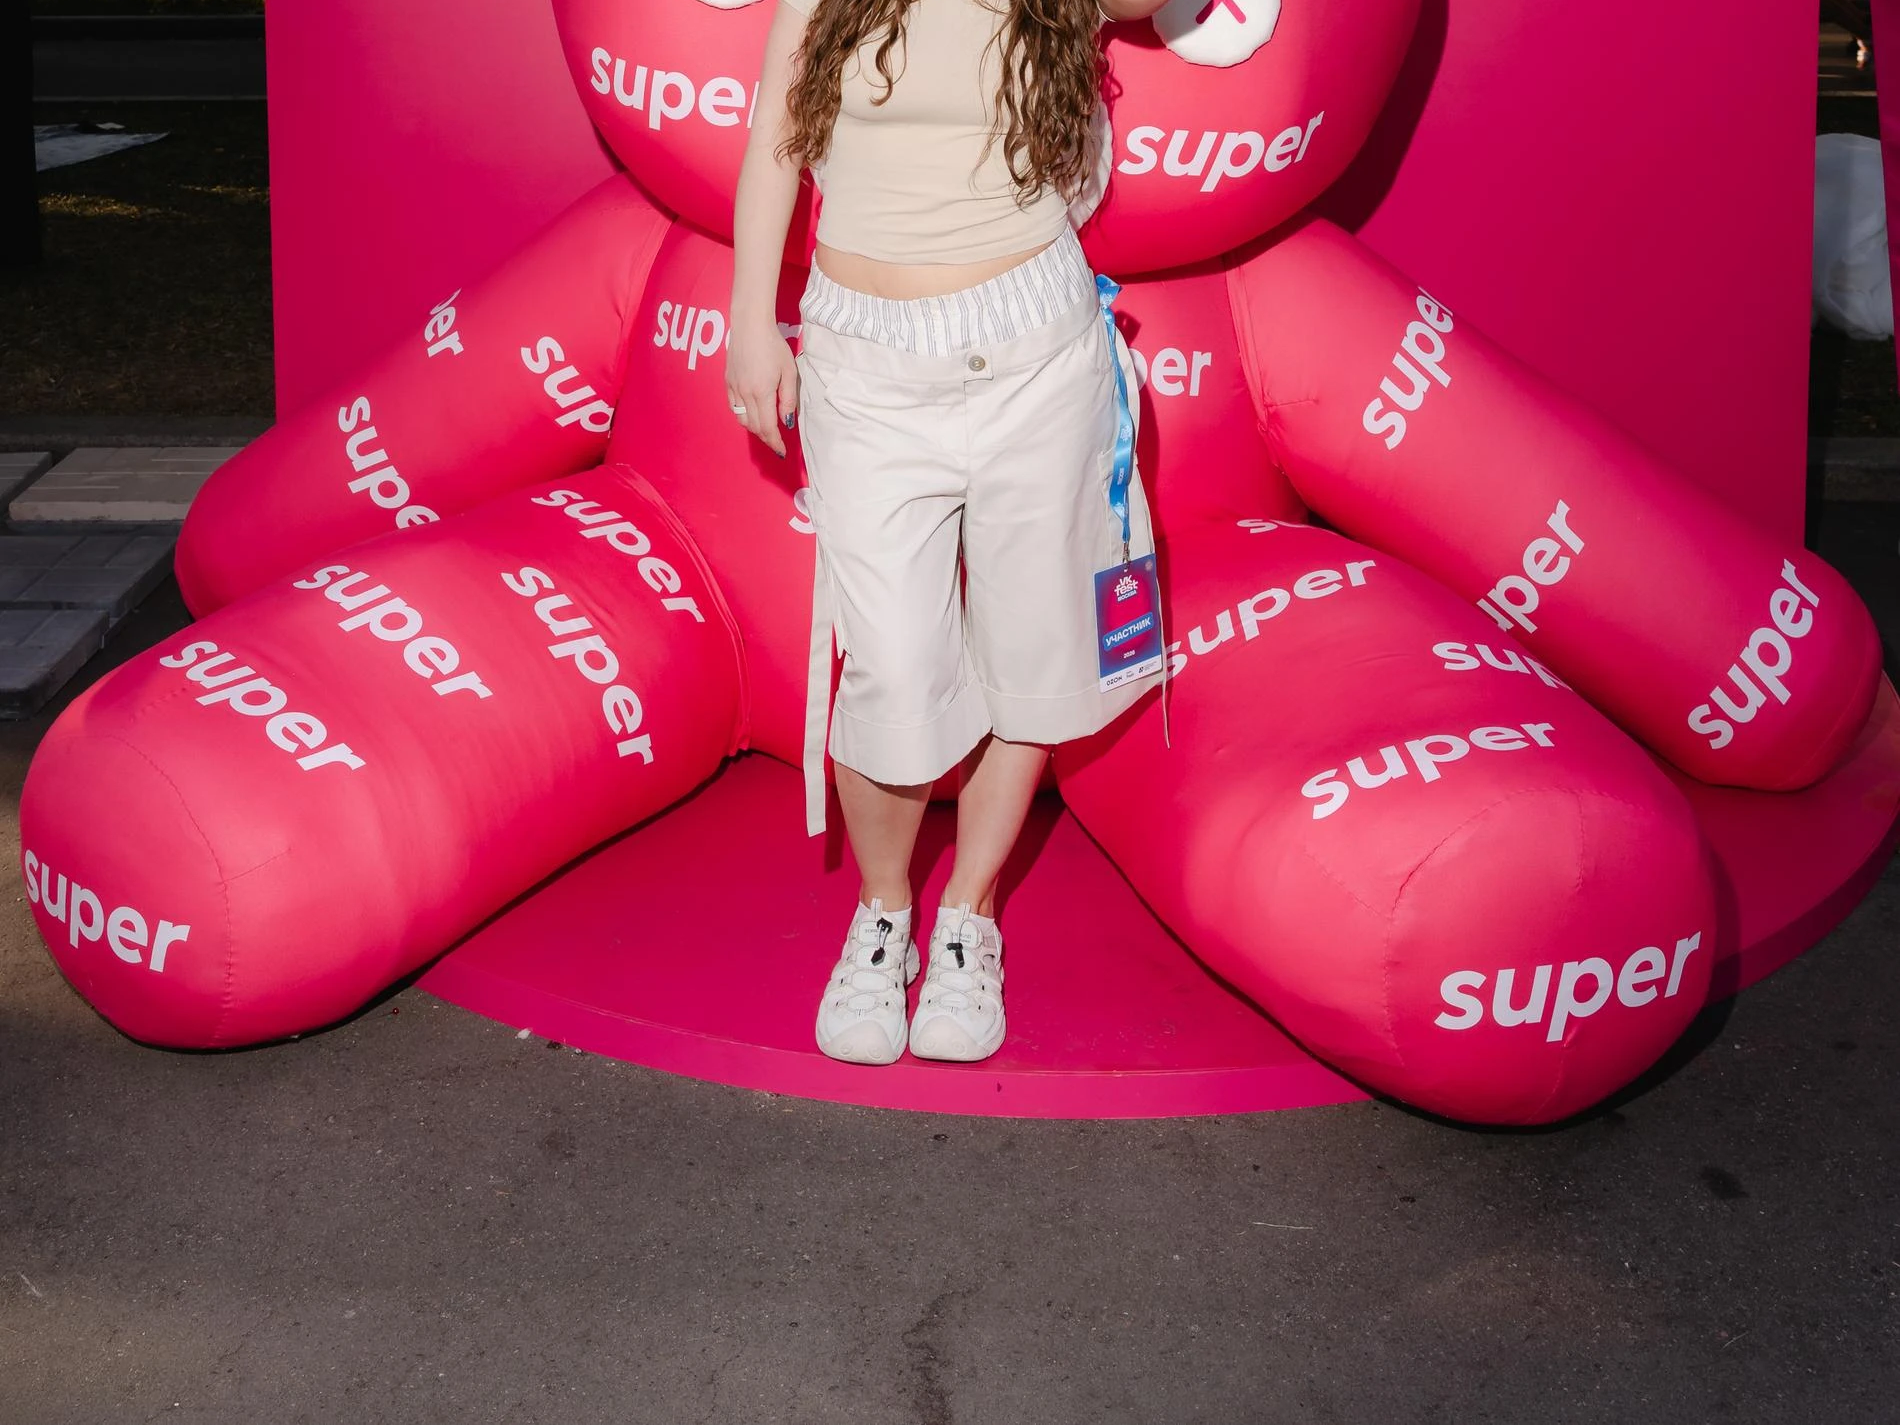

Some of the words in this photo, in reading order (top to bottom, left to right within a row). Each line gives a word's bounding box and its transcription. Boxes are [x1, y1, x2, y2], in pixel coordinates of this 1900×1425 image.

[1117, 111, 1324, 193] super
[520, 335, 615, 434] sup
[337, 395, 441, 528] supe
[531, 488, 705, 624] super
[1114, 579, 1139, 596] fest
[1120, 575, 1132, 586] VK
[292, 563, 494, 700] super
[500, 565, 655, 765] super
[1105, 617, 1152, 647] УЧАСТНИК
[1687, 557, 1820, 750] super
[159, 639, 366, 772] super
[1300, 721, 1555, 821] super
[24, 846, 191, 973] super
[1434, 930, 1702, 1042] super
